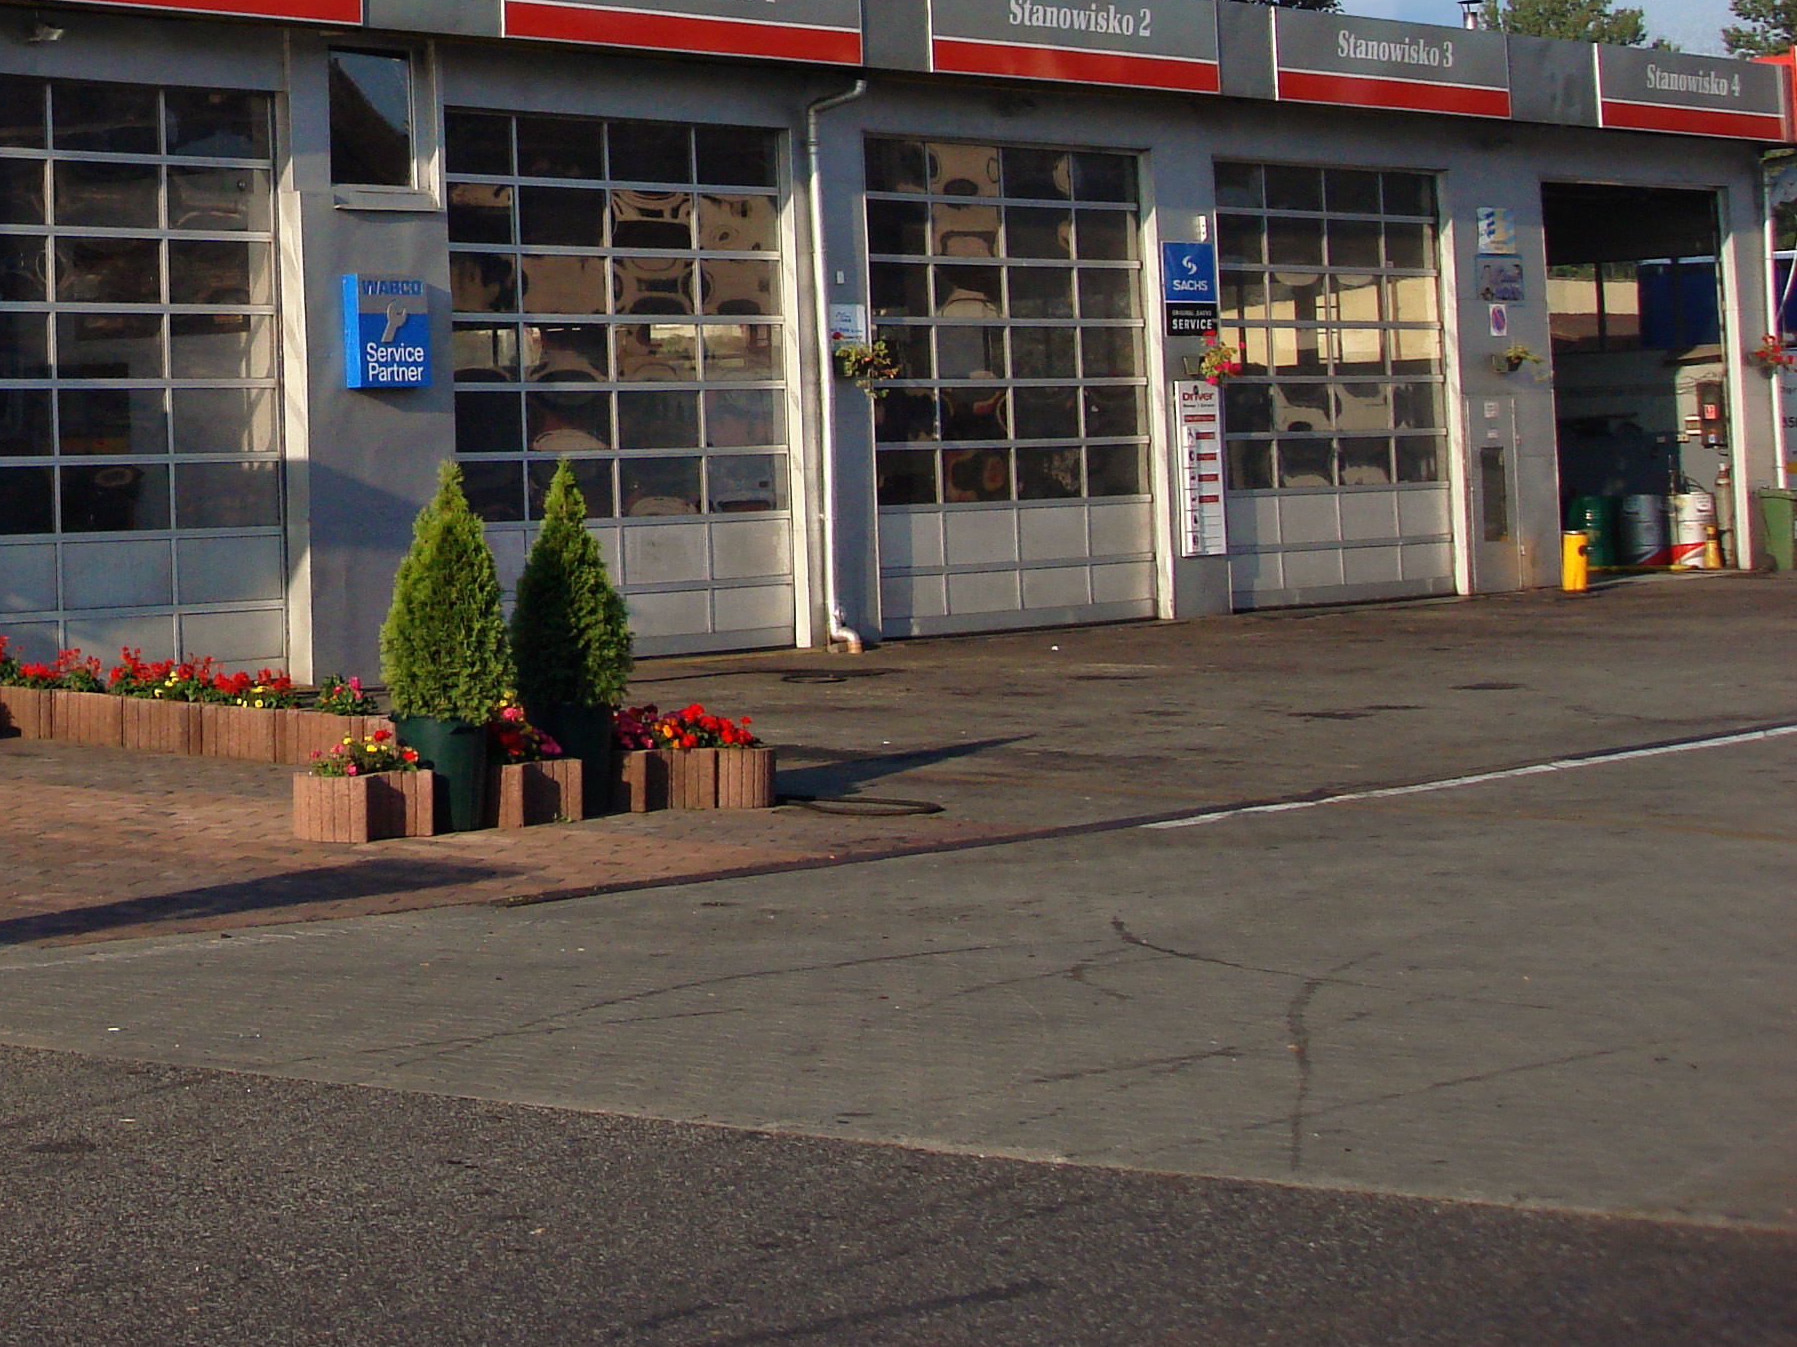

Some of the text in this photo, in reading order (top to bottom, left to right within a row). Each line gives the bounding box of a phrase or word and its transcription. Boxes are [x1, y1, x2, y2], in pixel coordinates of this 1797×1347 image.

[1138, 8, 1151, 37] 2
[1338, 30, 1453, 68] Stanowisko 3
[1647, 64, 1740, 97] Stanowisko 4
[362, 280, 422, 295] WABCO
[1172, 279, 1208, 291] SACHS
[1172, 318, 1212, 330] SERVICE
[366, 342, 424, 362] Service
[368, 363, 423, 381] Partner
[1182, 392, 1214, 401] Driver
